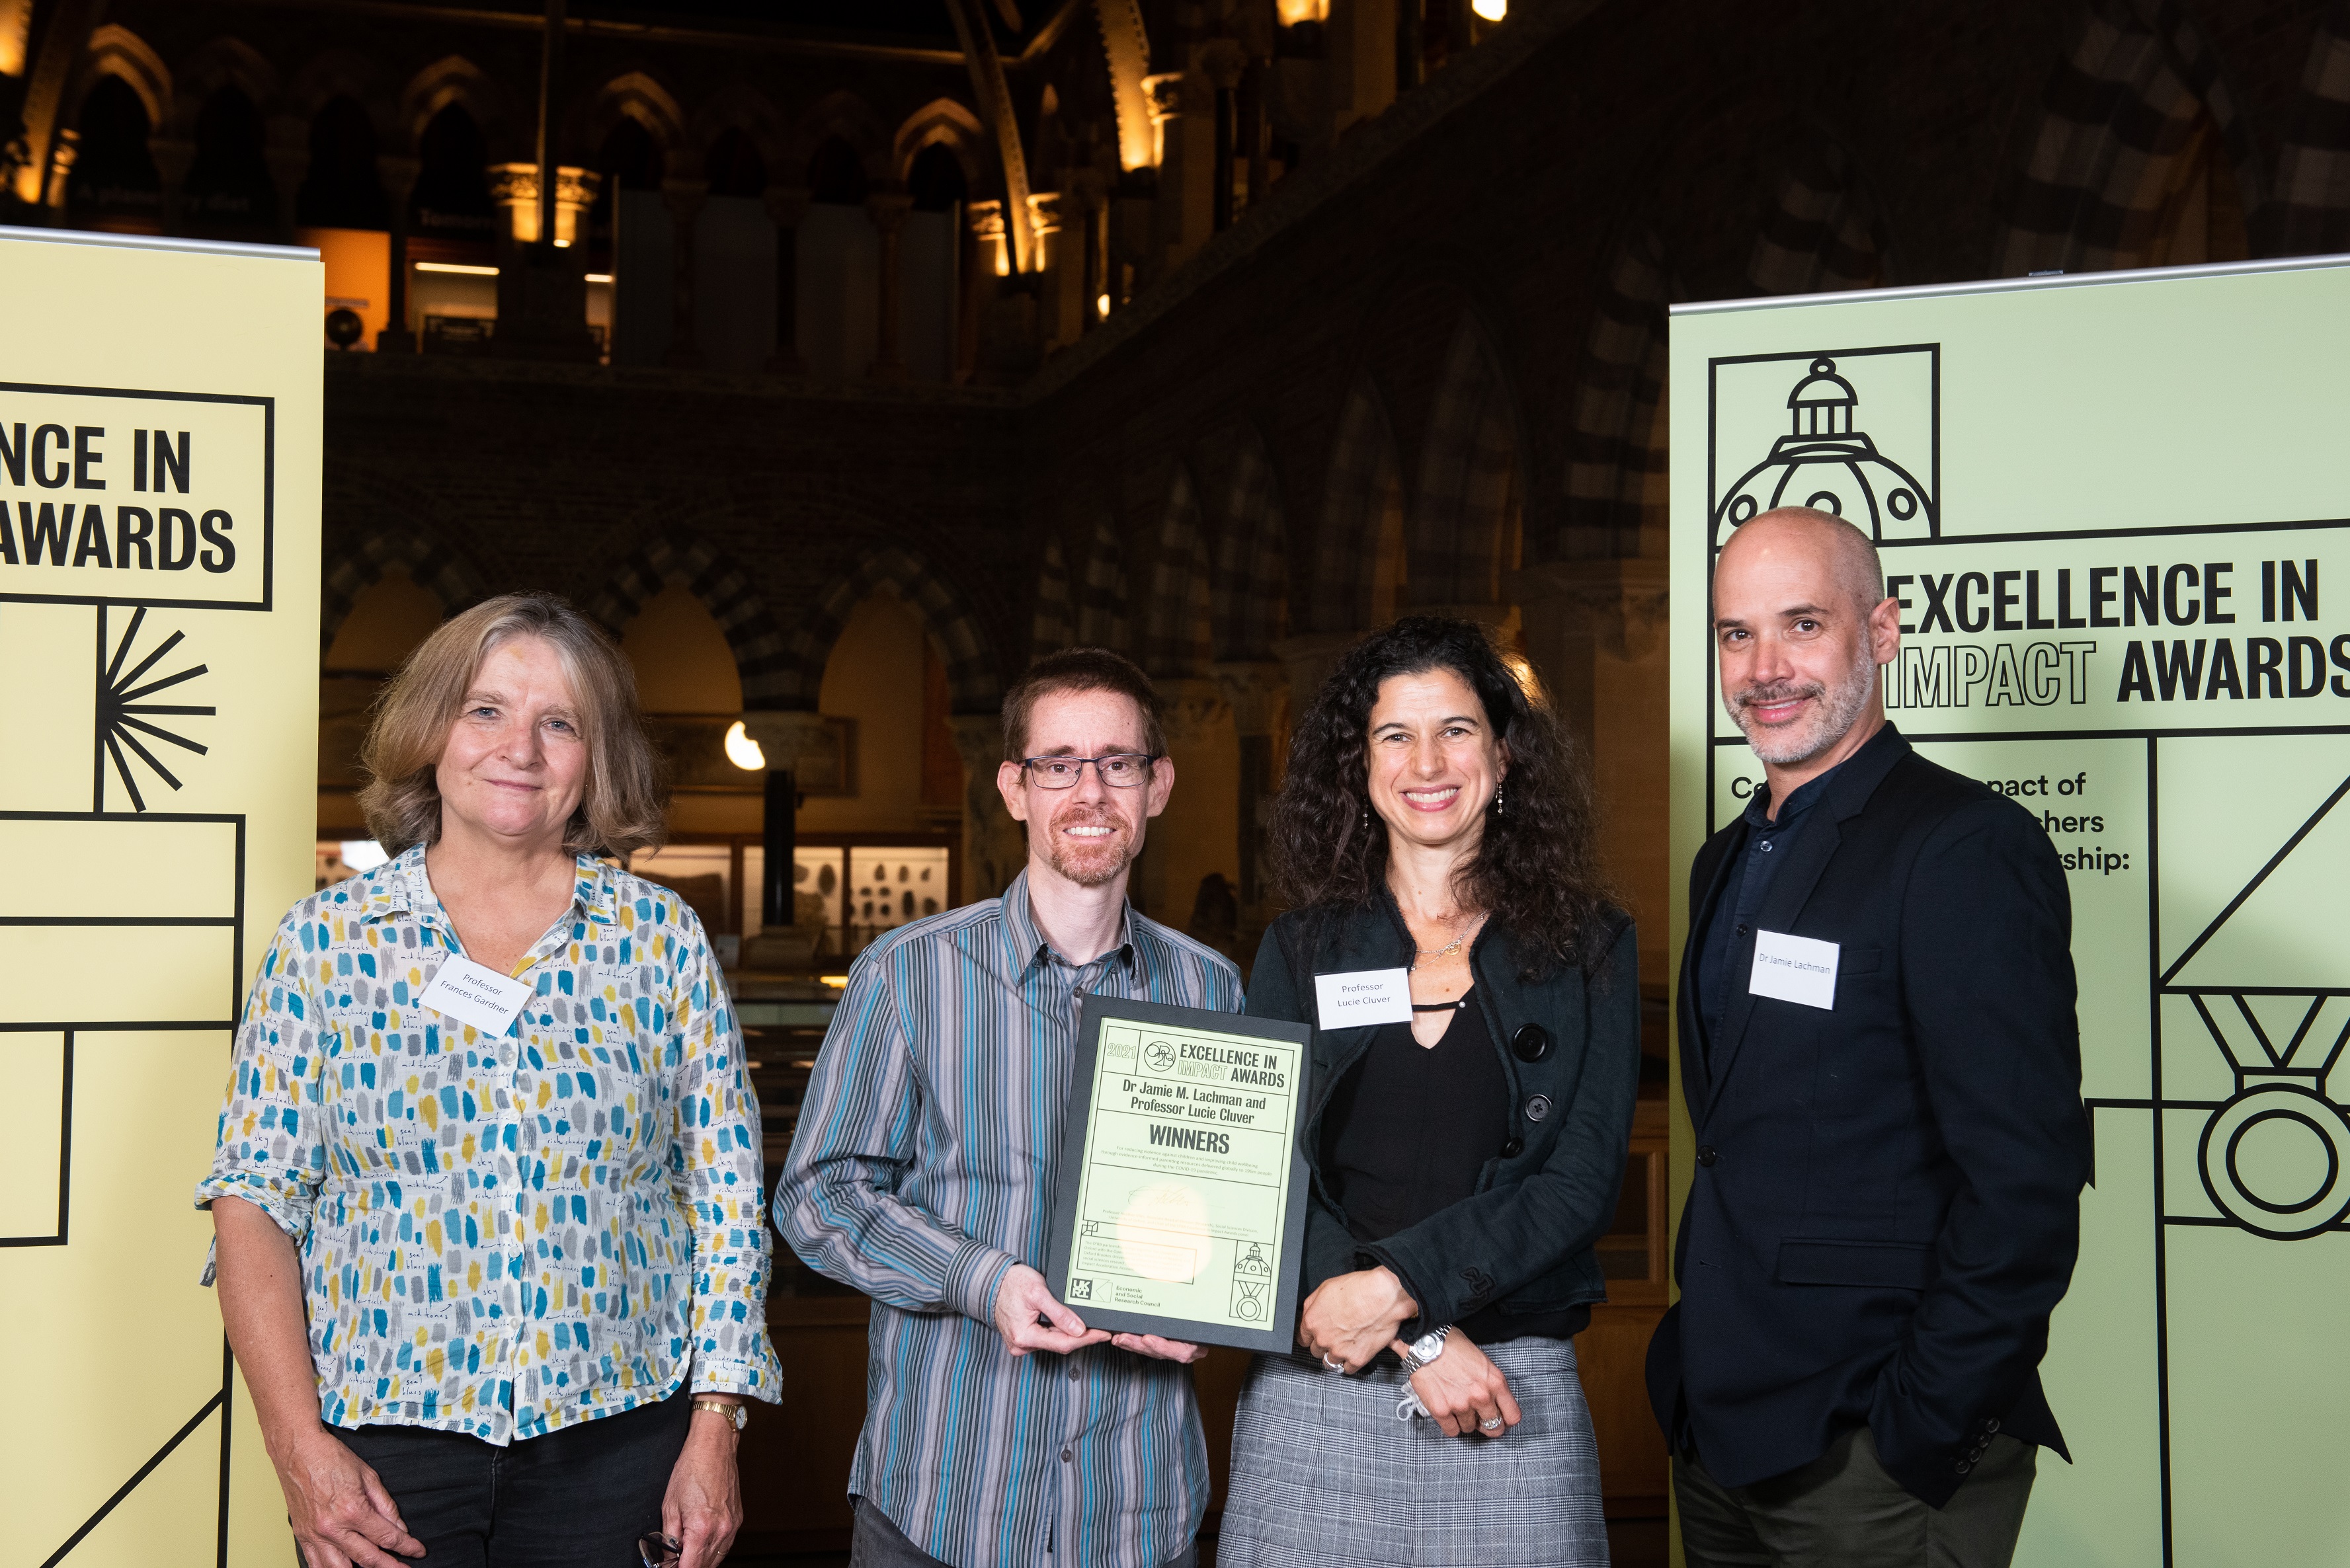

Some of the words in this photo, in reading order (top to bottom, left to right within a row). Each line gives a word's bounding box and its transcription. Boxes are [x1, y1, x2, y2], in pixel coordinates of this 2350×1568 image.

[134, 429, 190, 493] IN
[1886, 562, 2236, 635] EXCELLENCE
[2261, 559, 2318, 622] IN
[1886, 641, 2097, 709] IMPACT
[2117, 636, 2350, 703] AWARDS
[2058, 772, 2086, 795] of
[1769, 956, 1792, 966] Jamie
[1795, 960, 1830, 974] Lachman
[335, 979, 349, 992] sky
[463, 974, 503, 996] Professor
[1342, 984, 1383, 992] Professor
[440, 980, 471, 999] Frances
[474, 996, 508, 1015] Gardner
[533, 1002, 549, 1012] sky
[479, 1041, 494, 1056] sky
[1108, 1042, 1137, 1059] 2021
[1180, 1044, 1259, 1068] EXCELLENCE
[1264, 1055, 1277, 1070] IN
[1178, 1060, 1227, 1080] IMPACT
[1231, 1068, 1285, 1088] AWARDS
[1123, 1079, 1137, 1092] Dr
[1140, 1082, 1172, 1097] Jamie
[1176, 1086, 1189, 1099] M.
[1194, 1089, 1242, 1107] Lachman
[1246, 1097, 1266, 1109] and
[549, 1102, 565, 1118] sky
[1131, 1097, 1184, 1115] Professor
[1188, 1104, 1216, 1119] Lucie
[1220, 1109, 1254, 1124] Cluver
[255, 1132, 268, 1148] sky
[1150, 1124, 1230, 1154] WINNERS
[477, 1156, 493, 1173] sky
[718, 1157, 732, 1169] sky
[483, 1284, 498, 1302] sky
[552, 1353, 565, 1369] sky
[477, 1409, 491, 1423] sky
